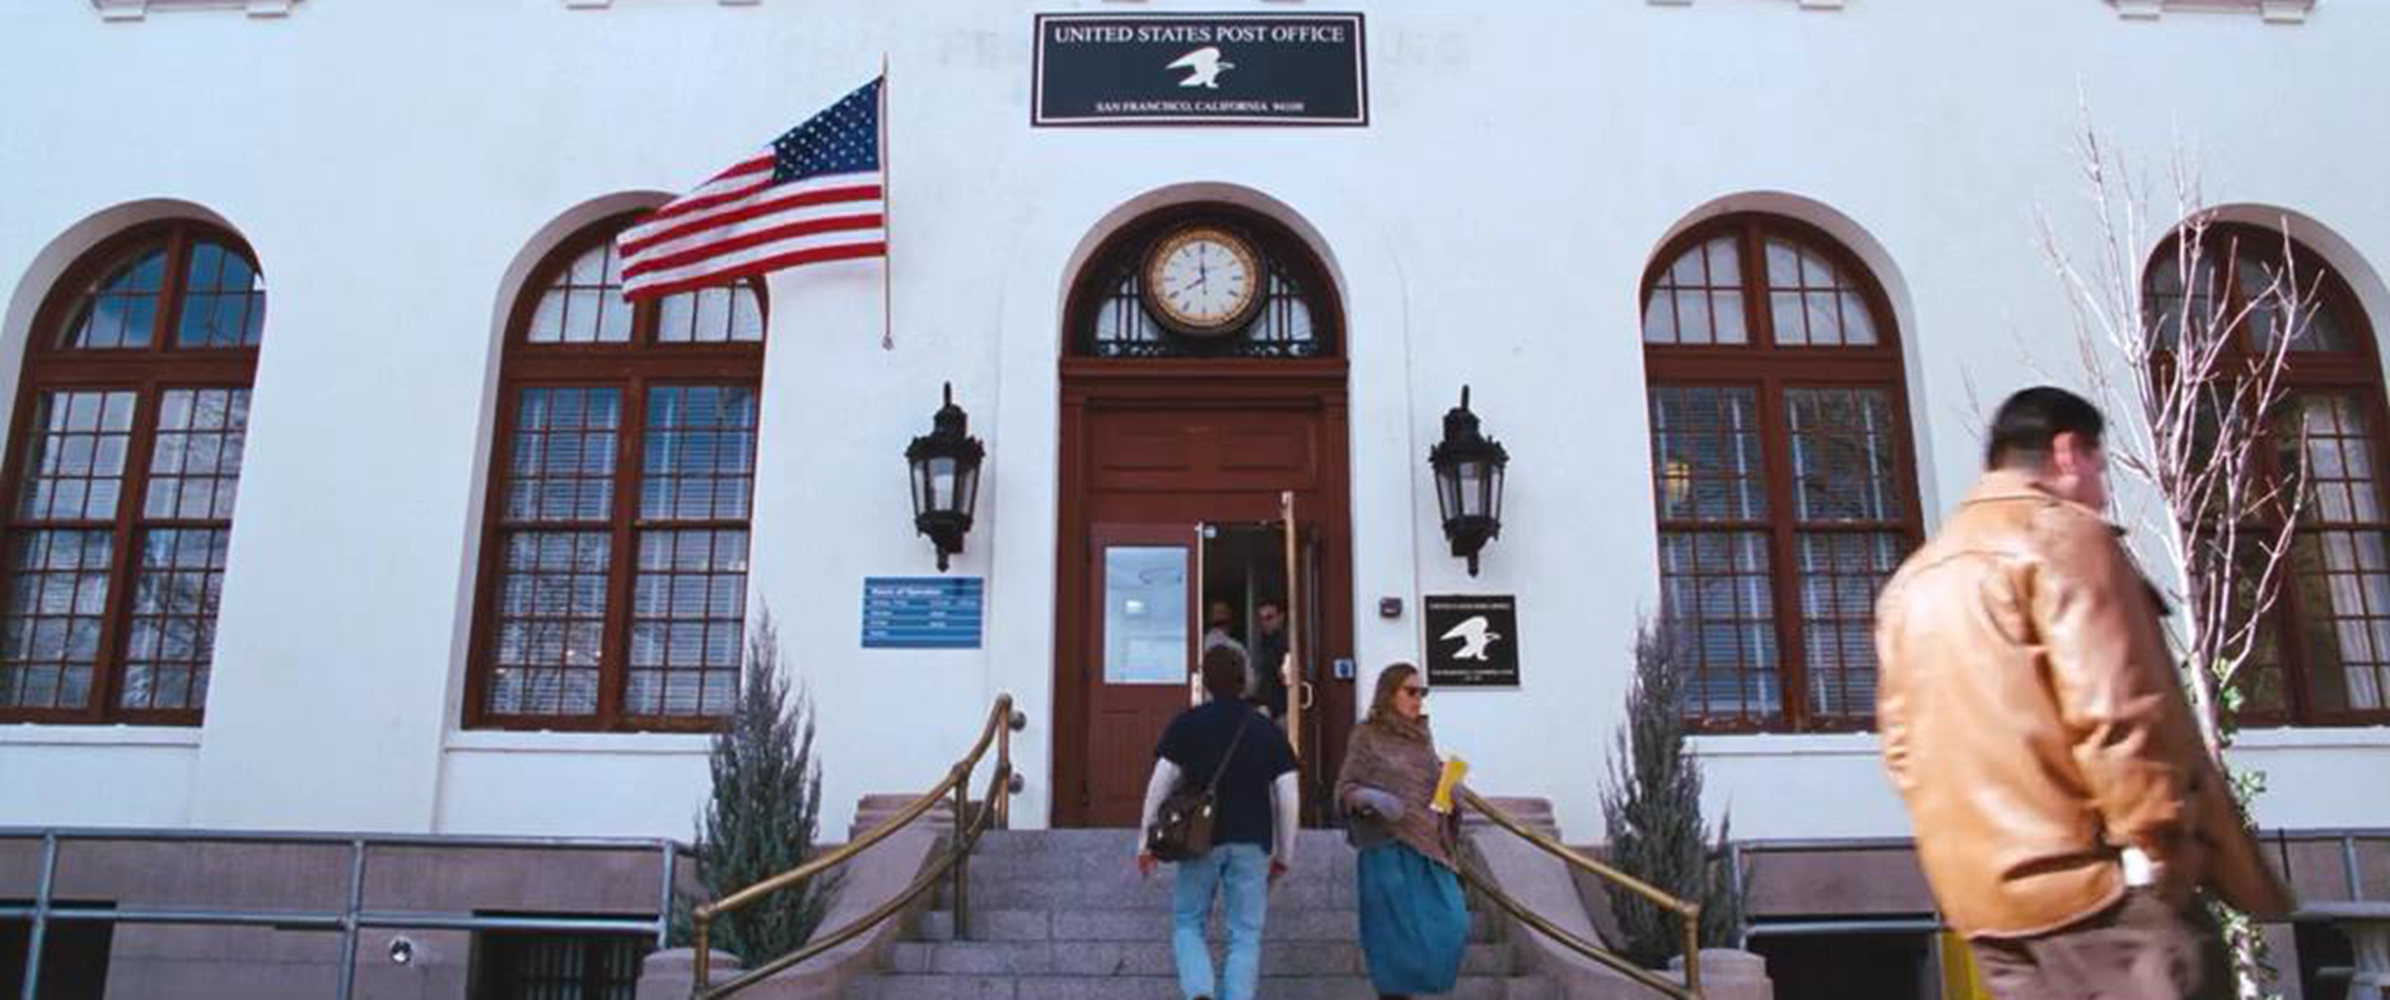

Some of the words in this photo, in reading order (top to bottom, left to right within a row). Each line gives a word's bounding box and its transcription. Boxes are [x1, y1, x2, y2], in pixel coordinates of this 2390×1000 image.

[1054, 26, 1133, 43] UNITED
[1137, 26, 1211, 42] STATES
[1216, 26, 1266, 42] POST
[1271, 26, 1345, 42] OFFICE
[1096, 102, 1121, 112] SAN
[1194, 101, 1268, 112] CALIFORNIA
